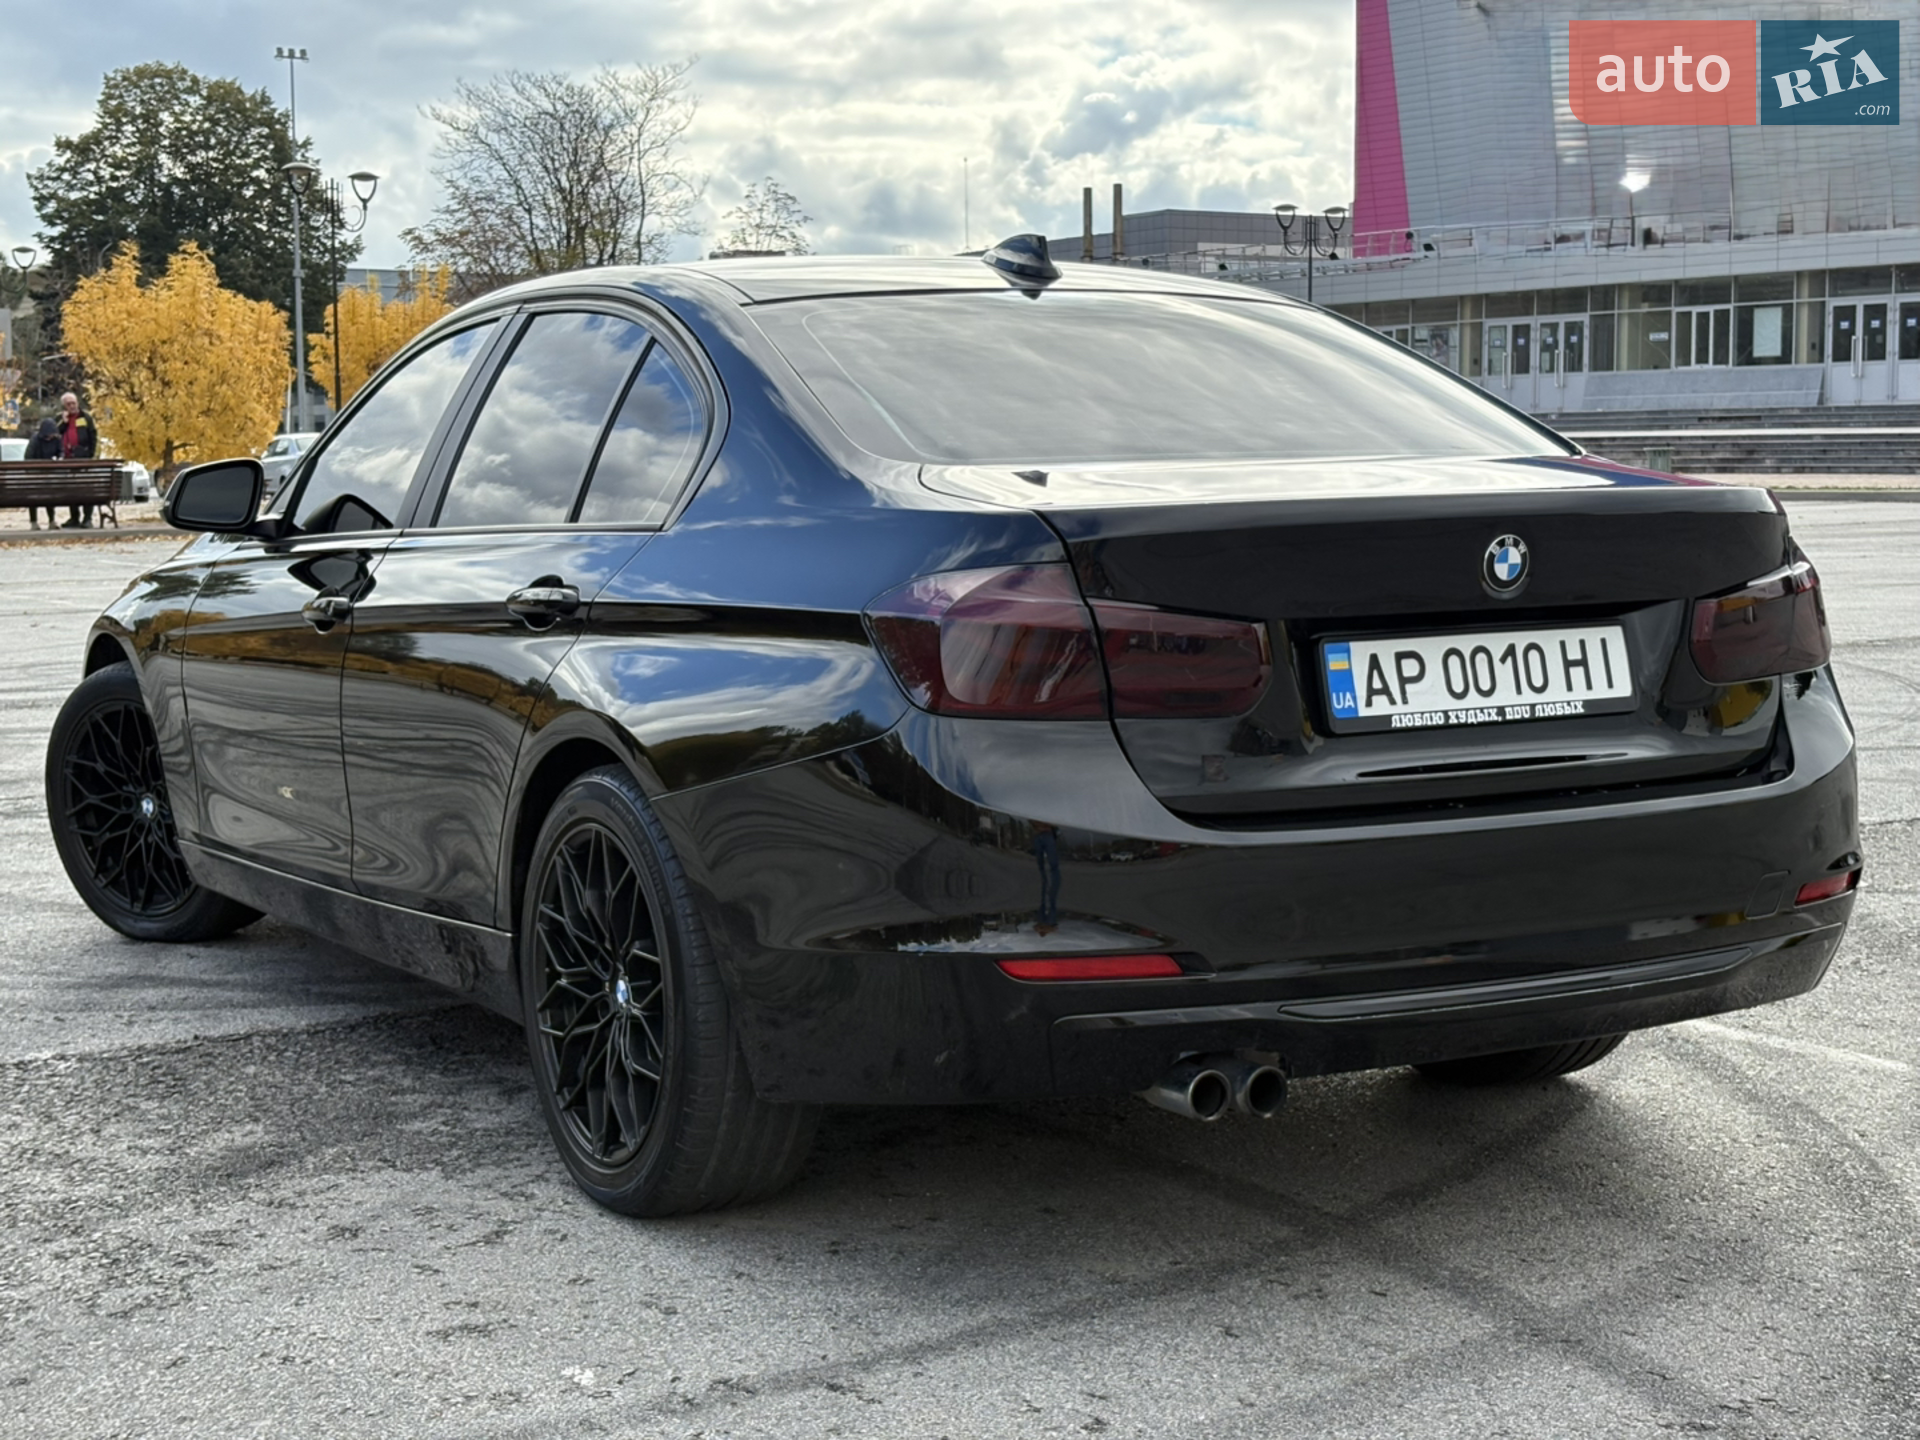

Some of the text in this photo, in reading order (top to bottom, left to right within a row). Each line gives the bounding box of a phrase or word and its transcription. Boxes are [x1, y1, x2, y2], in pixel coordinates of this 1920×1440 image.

[1365, 637, 1614, 708] AP 0010 HI
[1333, 692, 1355, 710] UA
